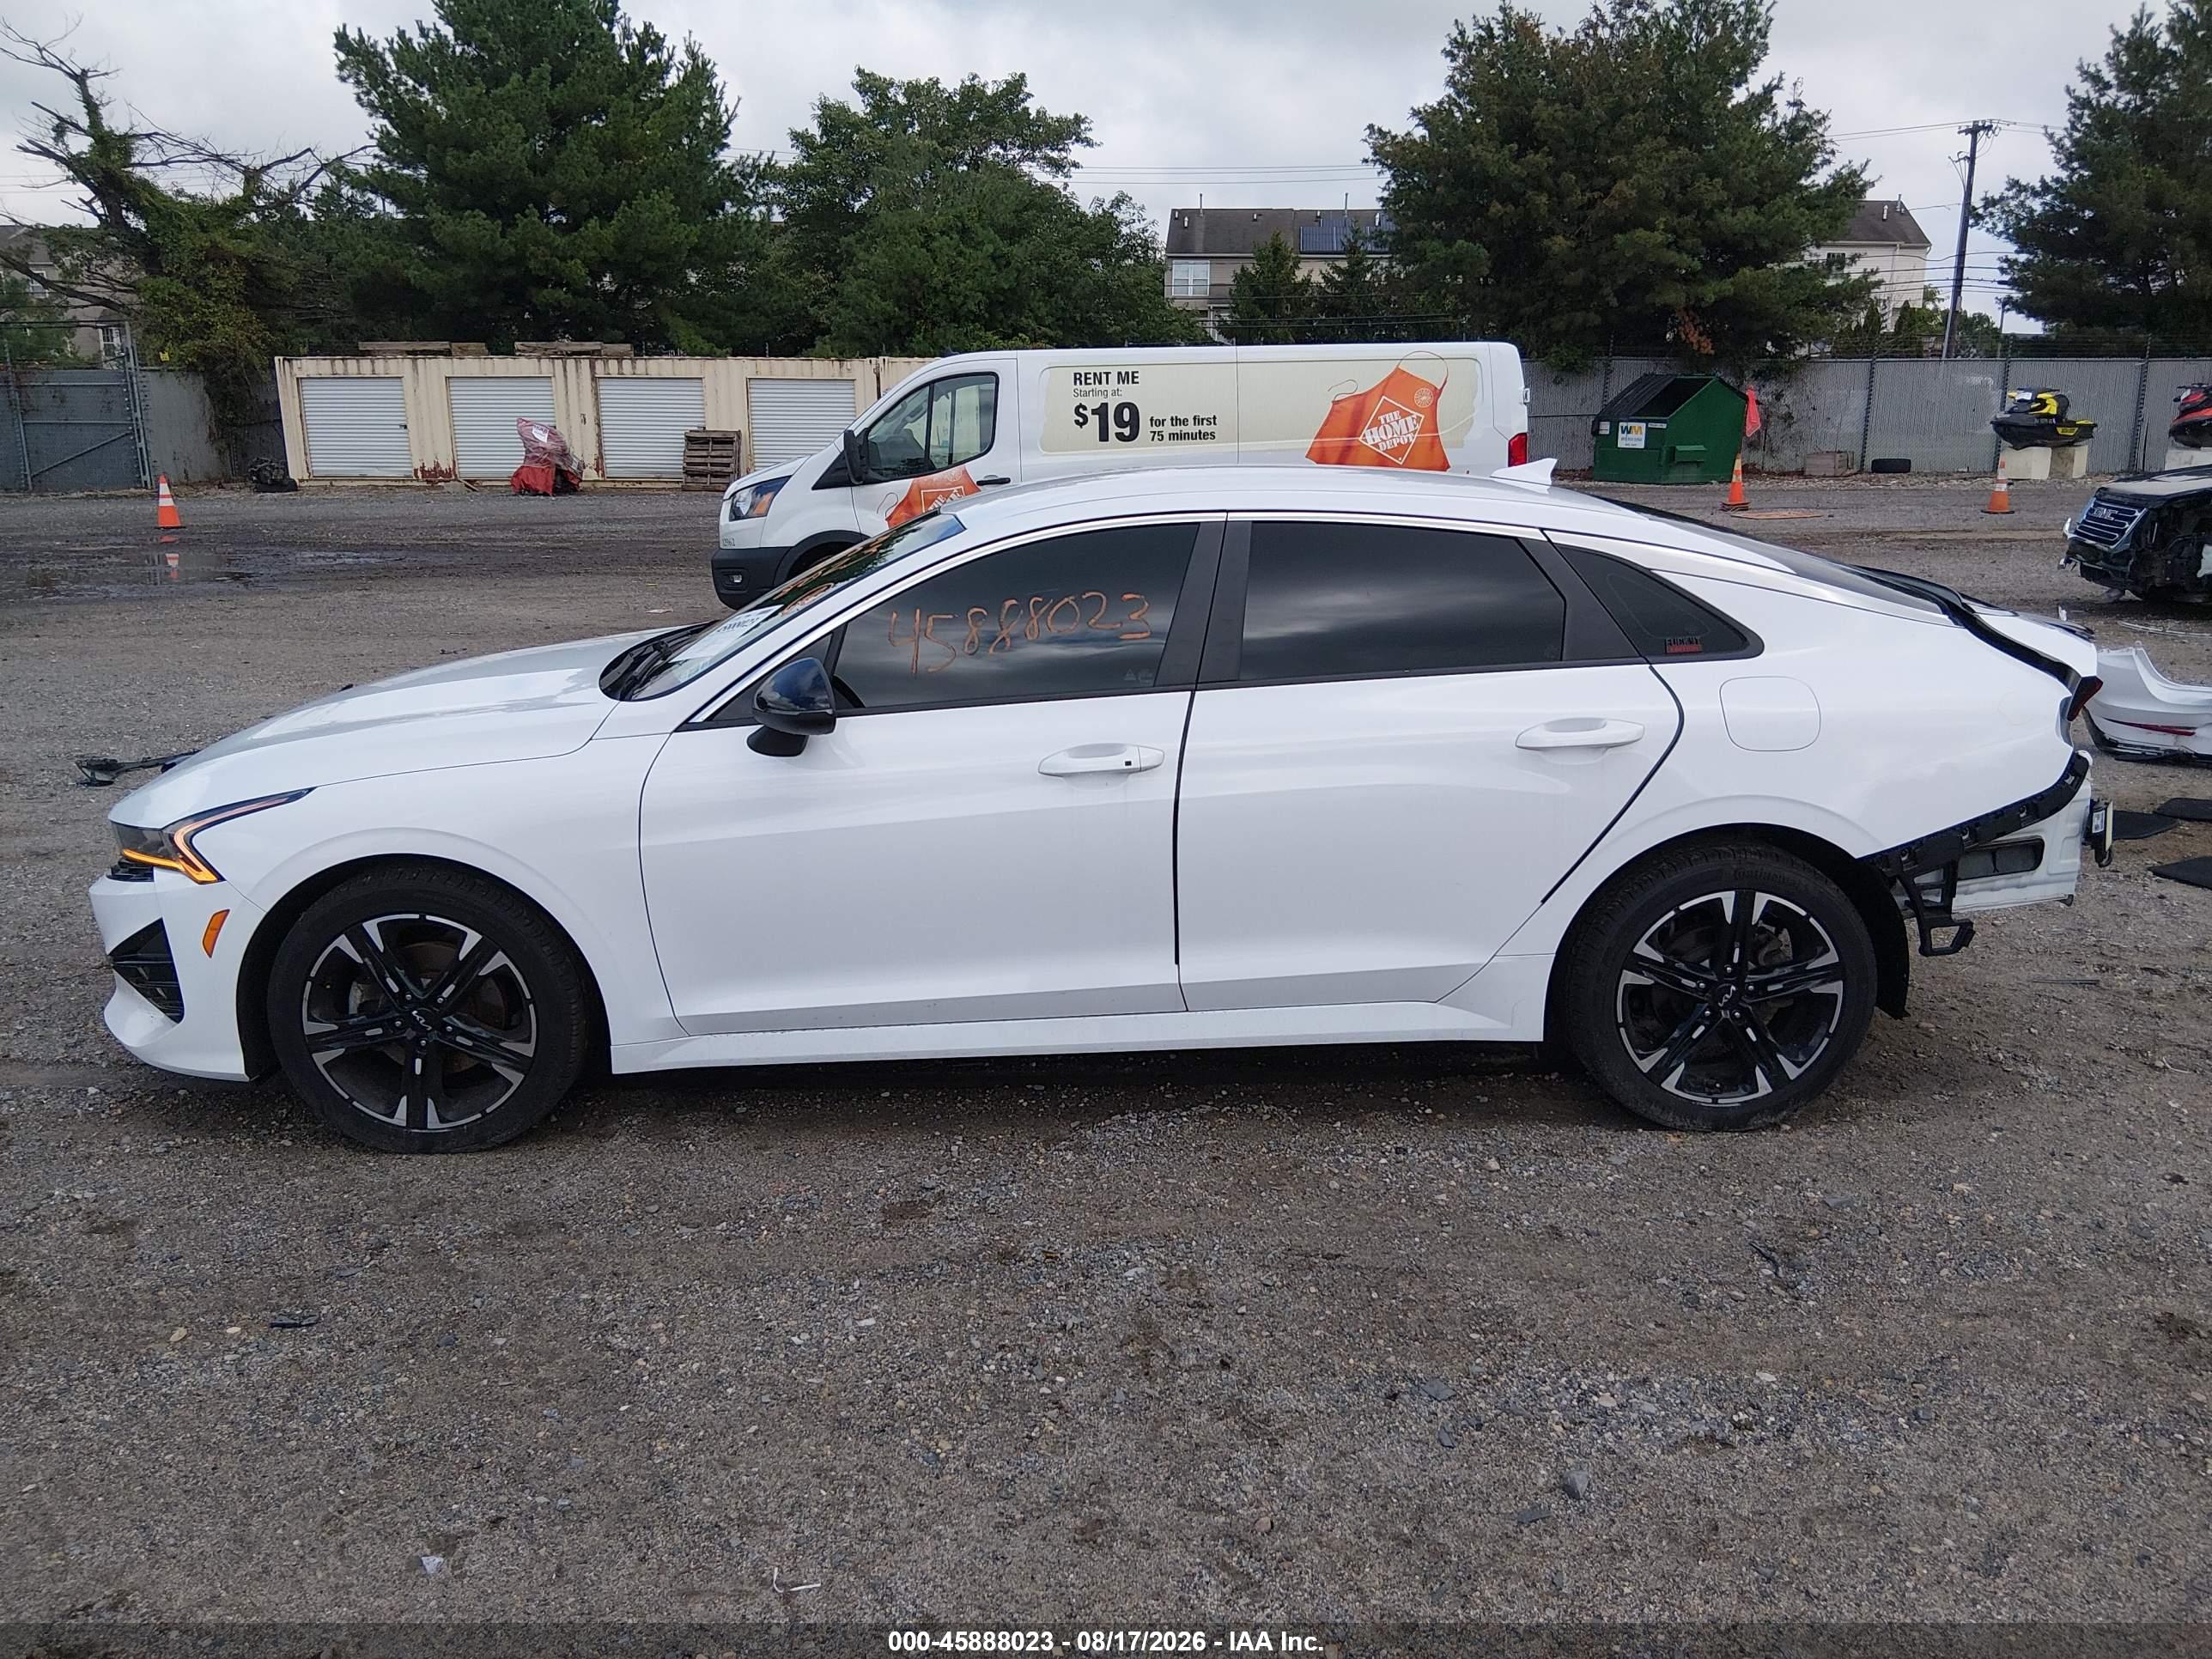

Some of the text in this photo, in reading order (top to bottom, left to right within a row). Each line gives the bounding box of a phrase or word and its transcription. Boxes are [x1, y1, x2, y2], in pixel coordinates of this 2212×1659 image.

[1073, 371, 1139, 386] RENT ME
[1073, 388, 1122, 398] Starting at:
[1074, 402, 1140, 442] $19
[1150, 415, 1217, 427] for the first
[1378, 410, 1401, 425] THE
[1150, 430, 1216, 441] 75 minutes
[1364, 415, 1419, 445] HOME
[1620, 426, 1643, 434] WM
[1378, 433, 1415, 452] DEPOT
[887, 591, 1152, 674] 45888023
